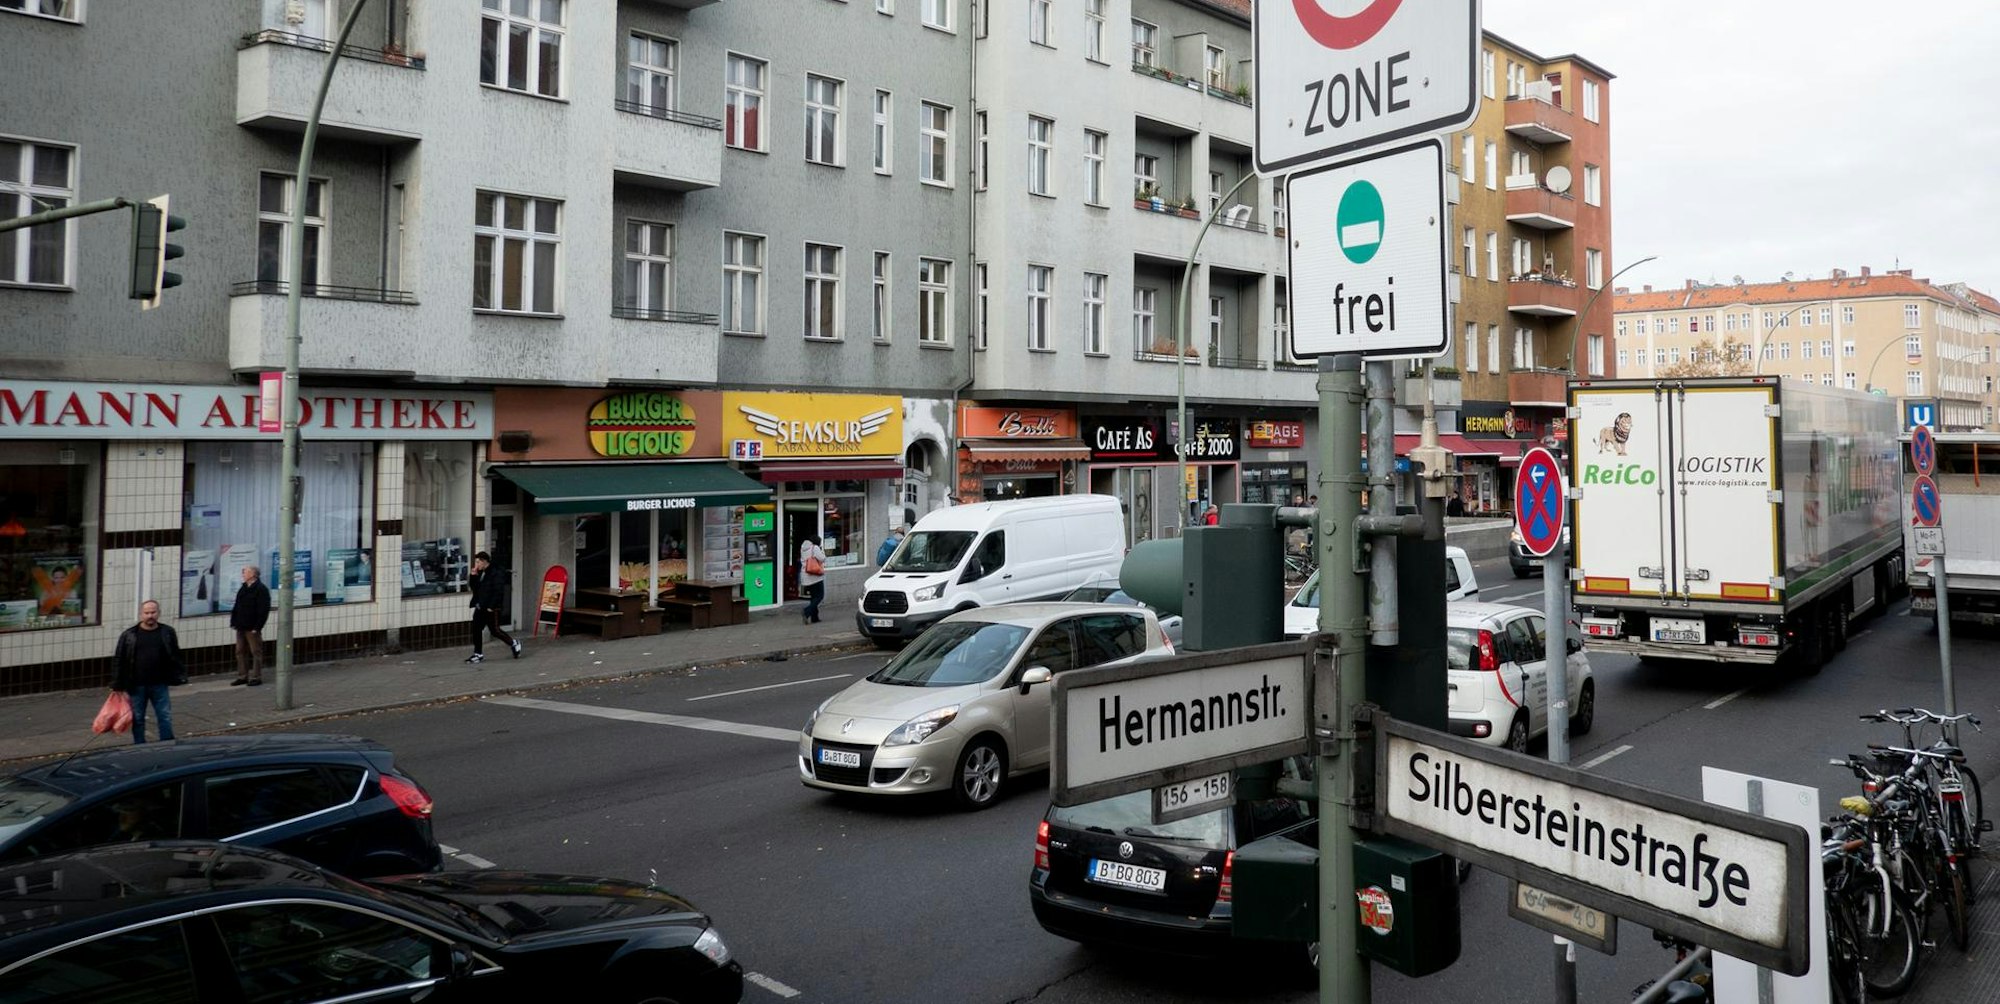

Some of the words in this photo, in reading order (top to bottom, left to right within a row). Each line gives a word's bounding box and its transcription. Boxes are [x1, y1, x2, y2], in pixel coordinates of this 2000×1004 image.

[1304, 51, 1410, 136] ZONE
[1333, 276, 1395, 334] frei
[0, 389, 182, 427] MANN
[606, 393, 684, 420] BURGER
[1913, 407, 1930, 424] U
[777, 420, 861, 444] SEMSUR
[1466, 417, 1504, 432] HERMANN
[606, 431, 684, 457] LICIOUS
[775, 443, 811, 453] TABAX
[815, 443, 823, 452] &
[827, 443, 861, 452] DRINX
[1207, 438, 1233, 456] 2000
[1583, 464, 1656, 485] ReiCo
[1677, 457, 1766, 473] LOGISTIK
[1677, 479, 1768, 489] www.reico-logistik.com
[627, 500, 661, 511] BURGER
[663, 498, 696, 510] LICIOUS
[1099, 674, 1286, 753] Hermannstr.
[824, 750, 829, 761] B
[833, 752, 842, 763] BT
[844, 753, 857, 765] 800
[1164, 785, 1188, 807] 156
[1203, 776, 1227, 798] 158
[1408, 752, 1751, 908] Silbersteinstraße
[1100, 862, 1109, 877] B
[1116, 864, 1134, 881] BQ
[1135, 871, 1160, 886] 803
